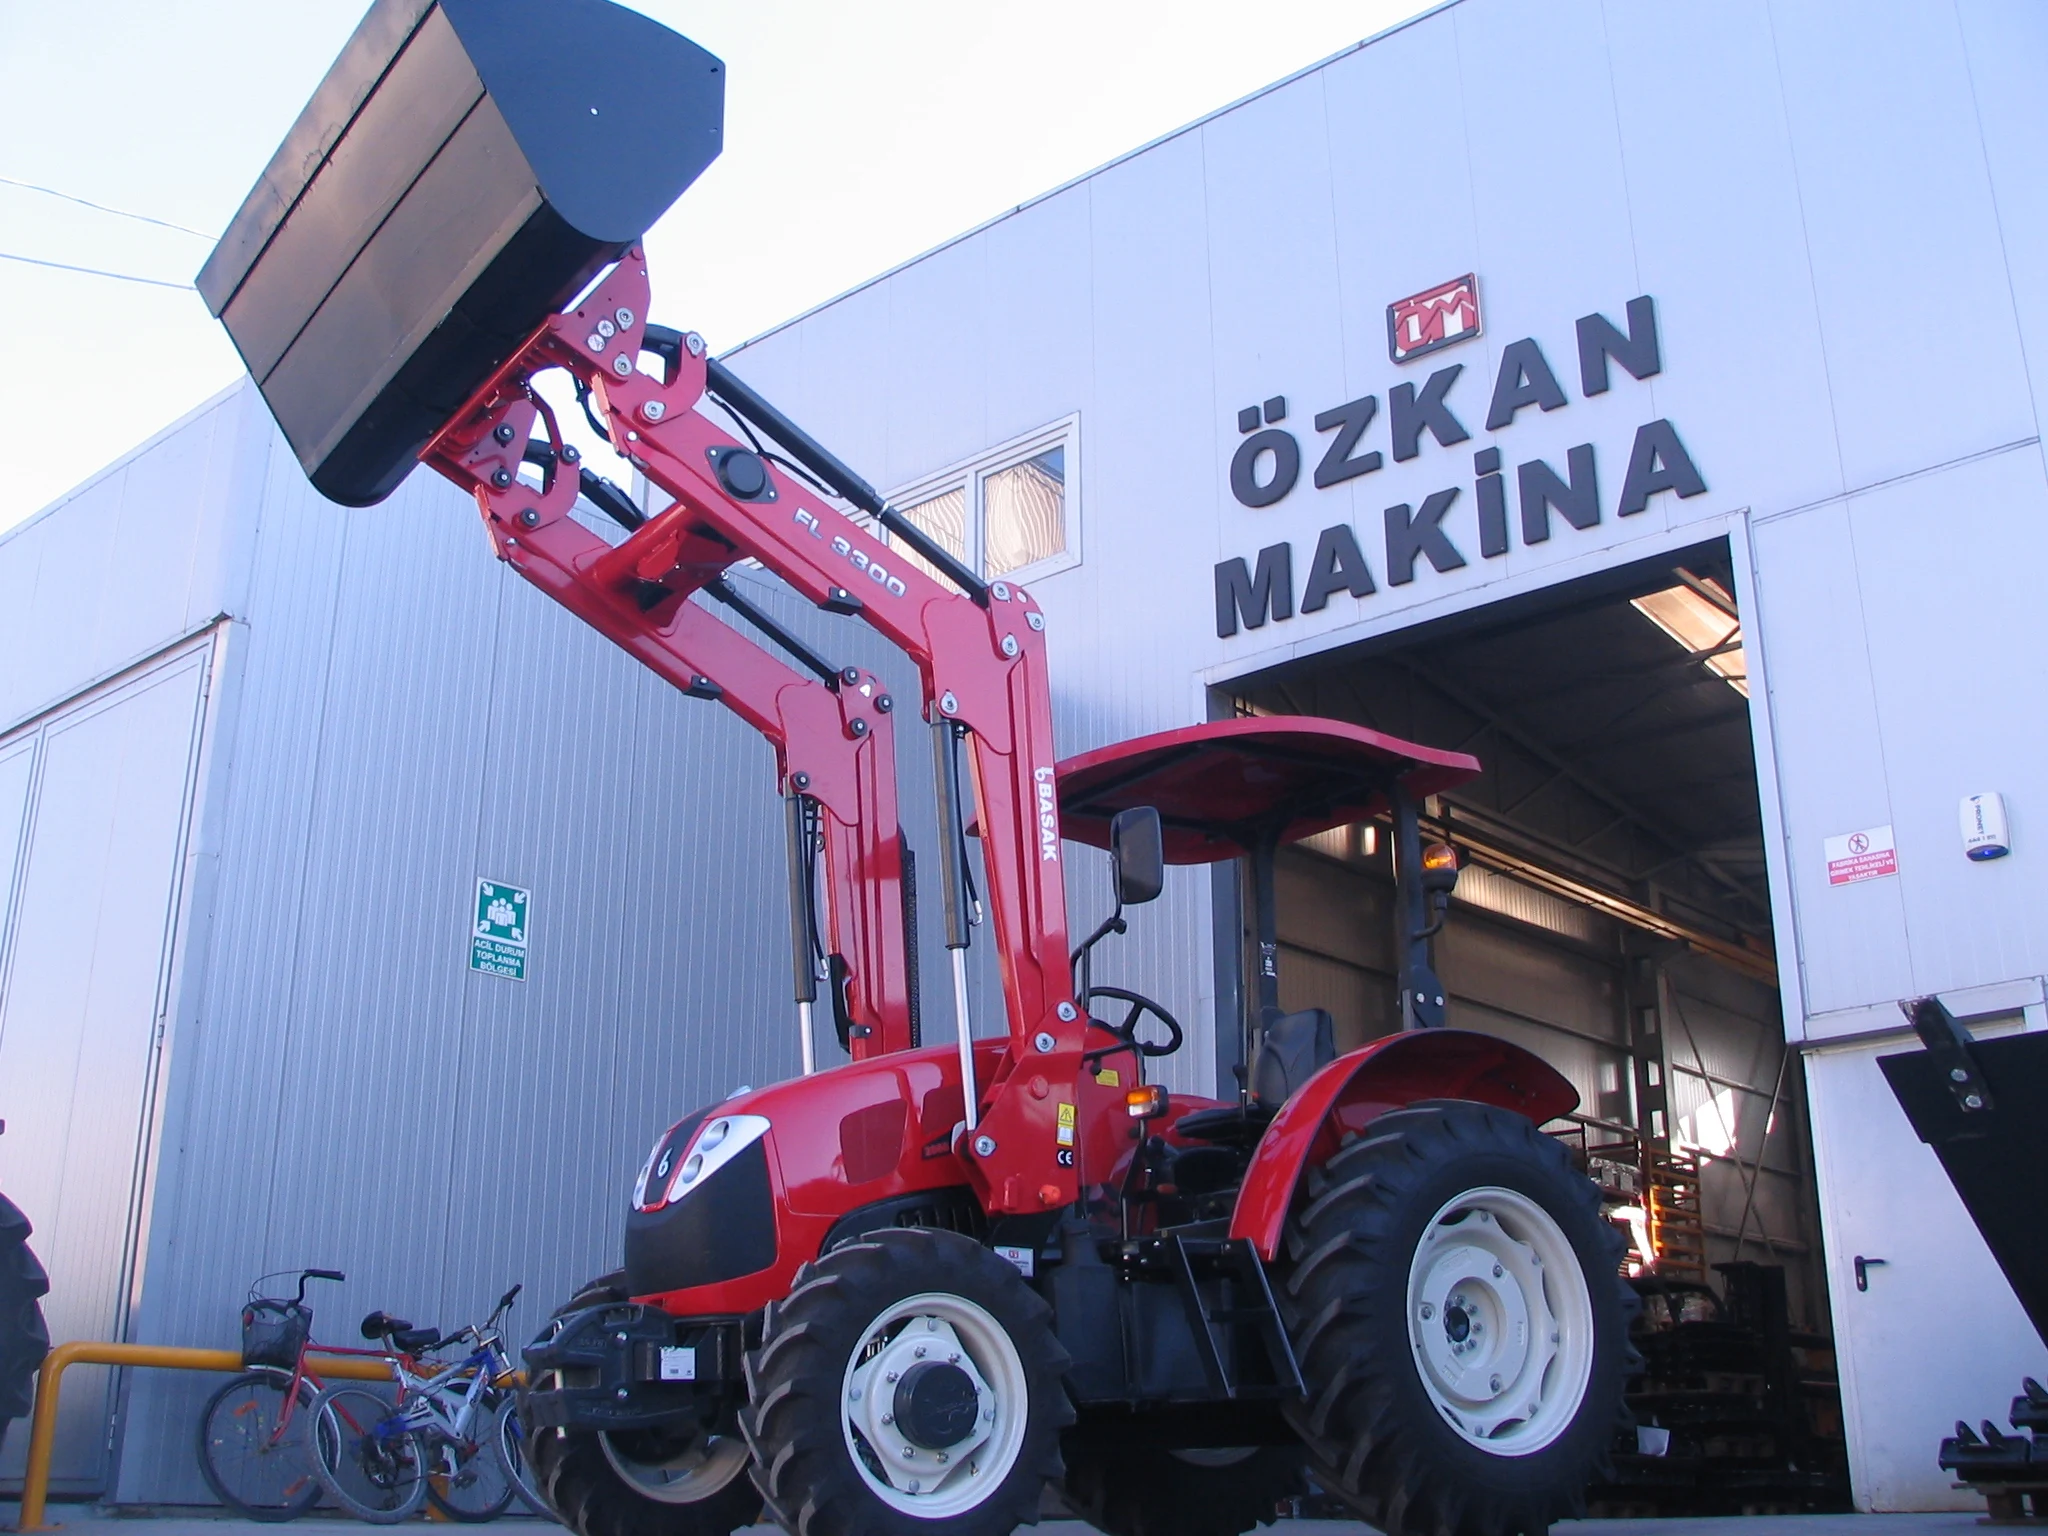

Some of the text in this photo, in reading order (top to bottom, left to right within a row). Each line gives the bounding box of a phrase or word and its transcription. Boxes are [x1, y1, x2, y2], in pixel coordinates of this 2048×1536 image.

[1230, 294, 1661, 508] ÖZKAN
[793, 506, 907, 598] FL 3300
[1214, 418, 1708, 638] MAKİNA
[476, 949, 521, 968] TOPLANMA
[495, 943, 525, 958] DURUM
[1057, 1150, 1073, 1165] CE
